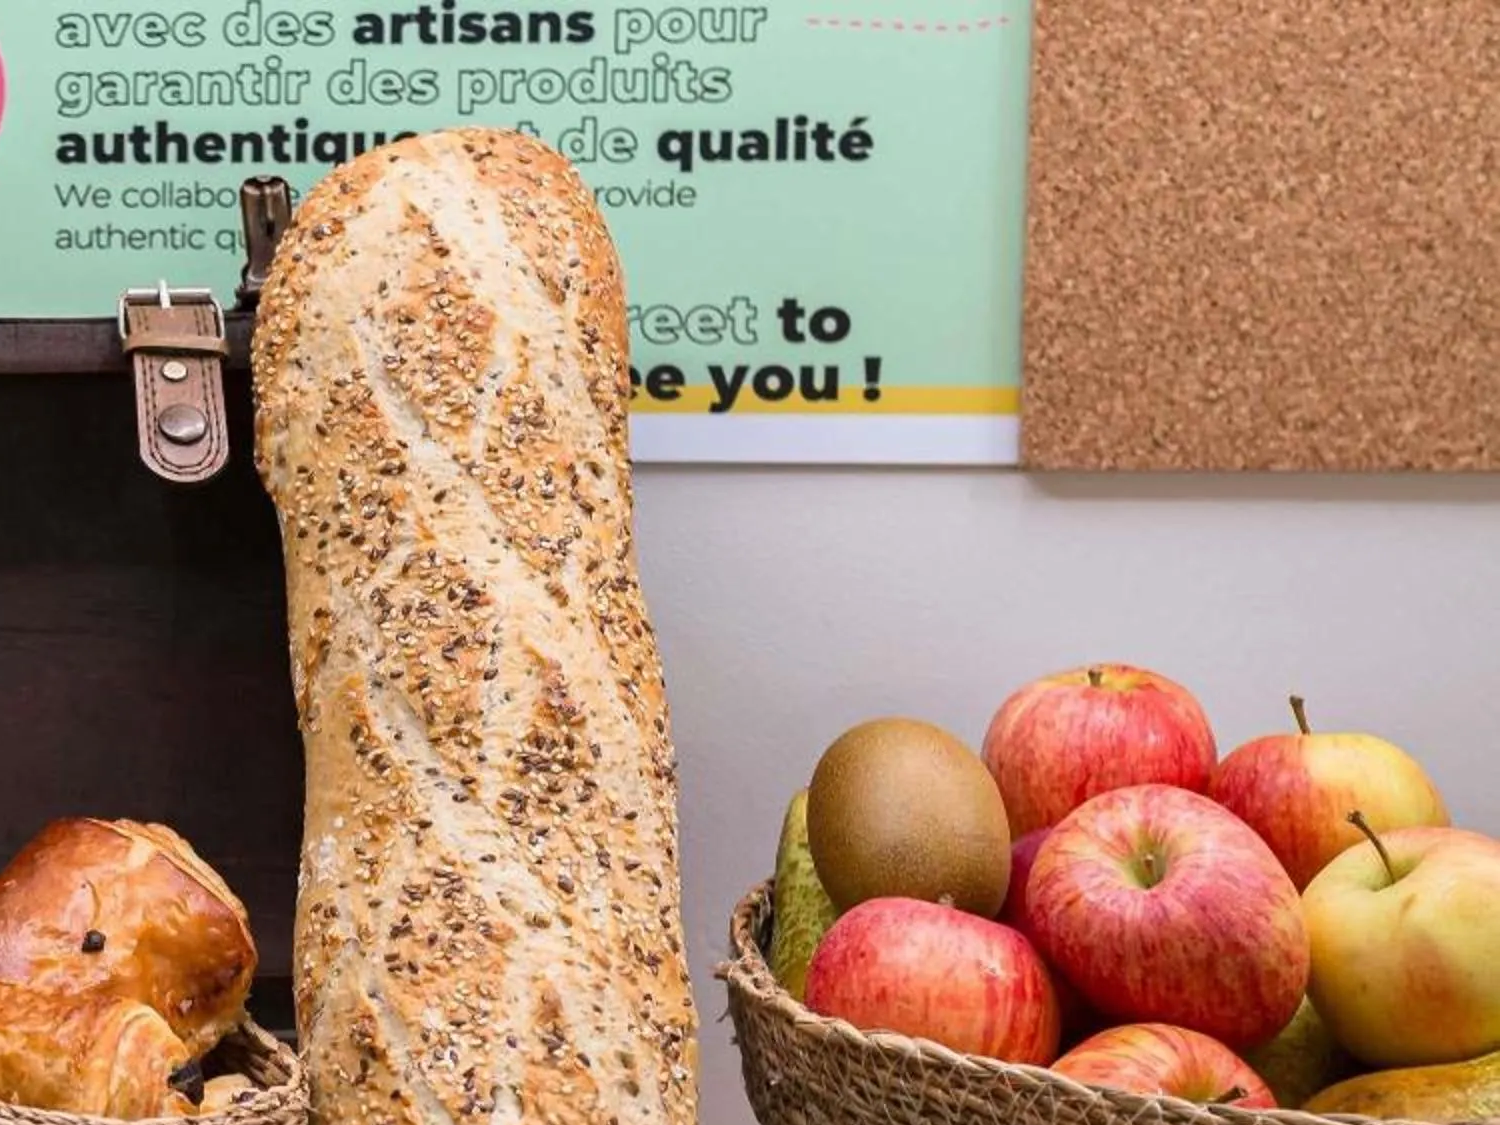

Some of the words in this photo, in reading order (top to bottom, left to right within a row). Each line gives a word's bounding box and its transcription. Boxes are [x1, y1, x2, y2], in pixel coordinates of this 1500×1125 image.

[55, 12, 206, 48] avec
[222, 0, 335, 47] des
[353, 0, 595, 45] artisans
[614, 6, 768, 54] pour
[55, 54, 311, 118] garantir
[327, 58, 440, 105] des
[457, 52, 733, 115] produits
[55, 117, 420, 167] authentiqu
[558, 116, 638, 163] de
[657, 114, 875, 172] qualité
[54, 183, 111, 208] We
[594, 179, 697, 208] rovide
[54, 224, 204, 250] authentic
[777, 297, 851, 344] to
[707, 363, 840, 413] you
